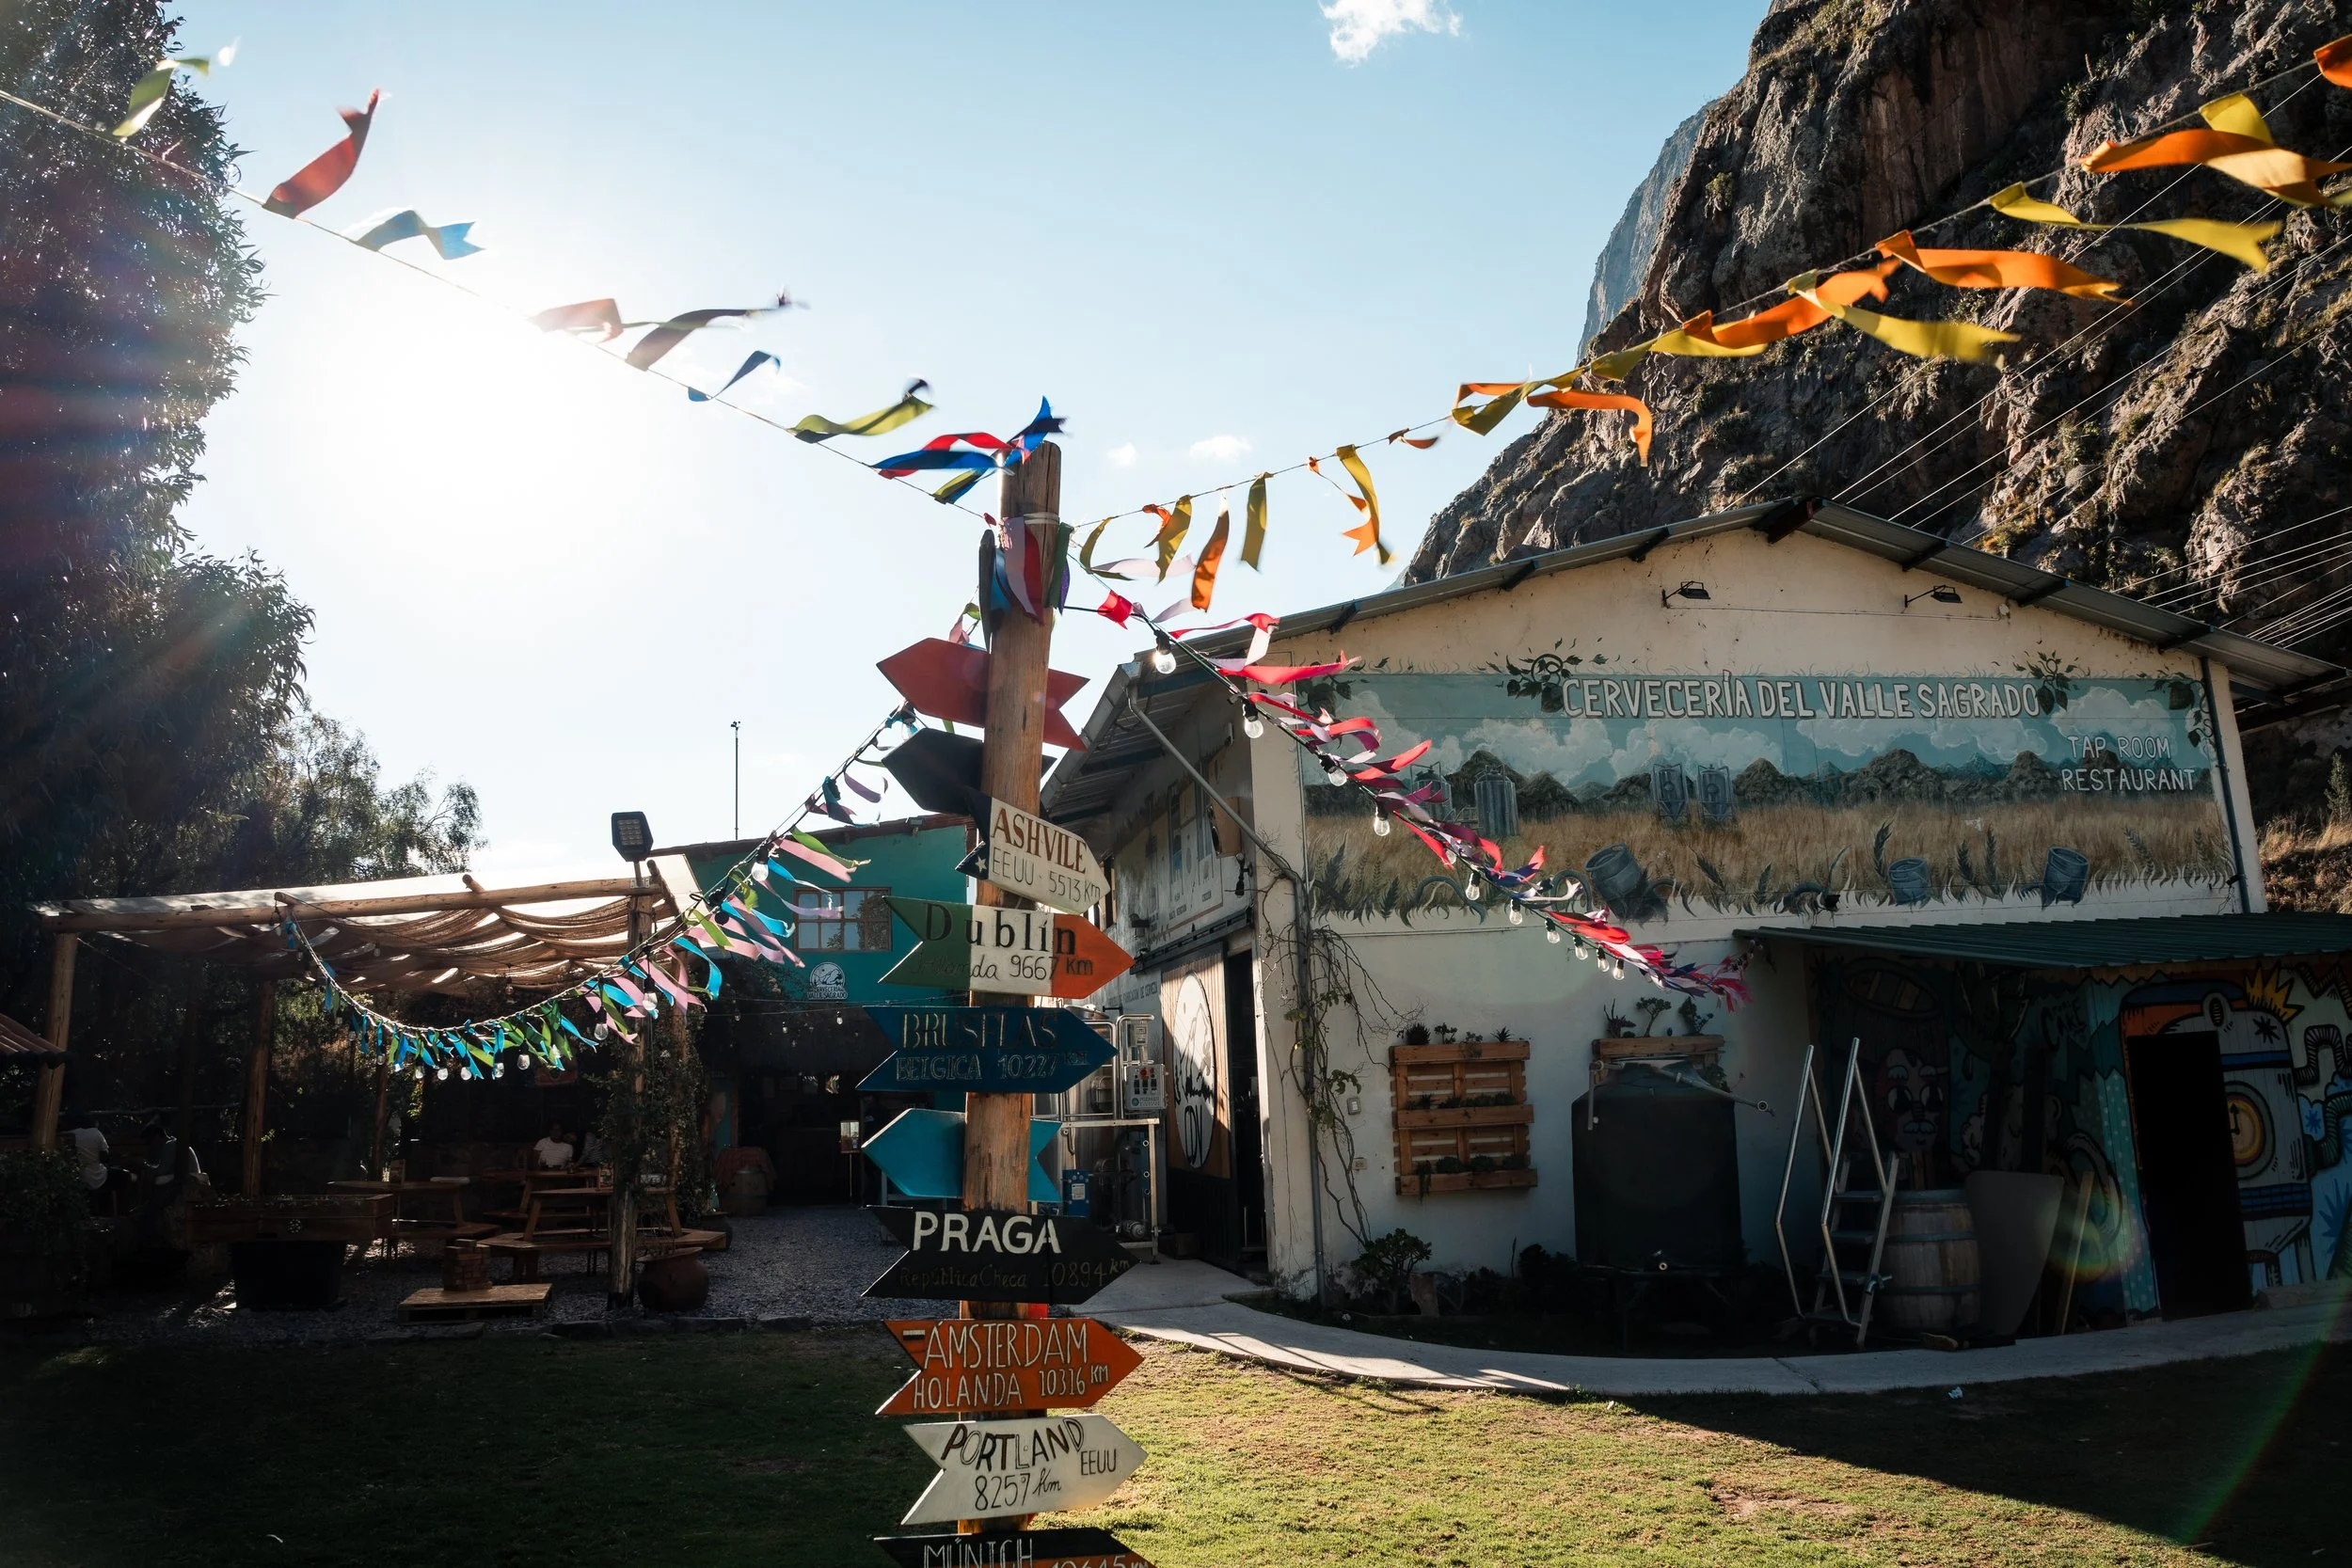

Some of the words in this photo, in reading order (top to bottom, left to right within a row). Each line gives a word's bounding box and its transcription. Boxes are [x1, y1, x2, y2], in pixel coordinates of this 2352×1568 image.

[1562, 670, 1754, 719] CERVECERÍA
[1757, 681, 1817, 720] DEL
[1818, 681, 1914, 720] VALLE
[1915, 682, 2040, 719] SAGRADO
[2067, 736, 2106, 759] TAP
[2119, 736, 2172, 760] ROOM
[2061, 768, 2195, 791] RESTAURANT
[991, 807, 1088, 875] ASHVILE
[993, 847, 1034, 885] EEUU
[1048, 871, 1081, 903] 5513
[923, 902, 1076, 955] Dublín
[1009, 955, 1058, 980] 9667
[902, 1012, 1058, 1050] BRUSELAS
[997, 1053, 1060, 1080] 10227
[912, 1211, 1062, 1254] PRAGA
[1041, 1261, 1106, 1289] 10894
[924, 1321, 1089, 1370] ÁMSTERDAM
[914, 1372, 1024, 1409] HOLANDA
[1039, 1368, 1086, 1397] 10316
[1090, 1365, 1109, 1384] KM
[941, 1418, 1085, 1472] PORTLAND
[1081, 1449, 1118, 1476] EEUU
[975, 1472, 1031, 1511] 8257
